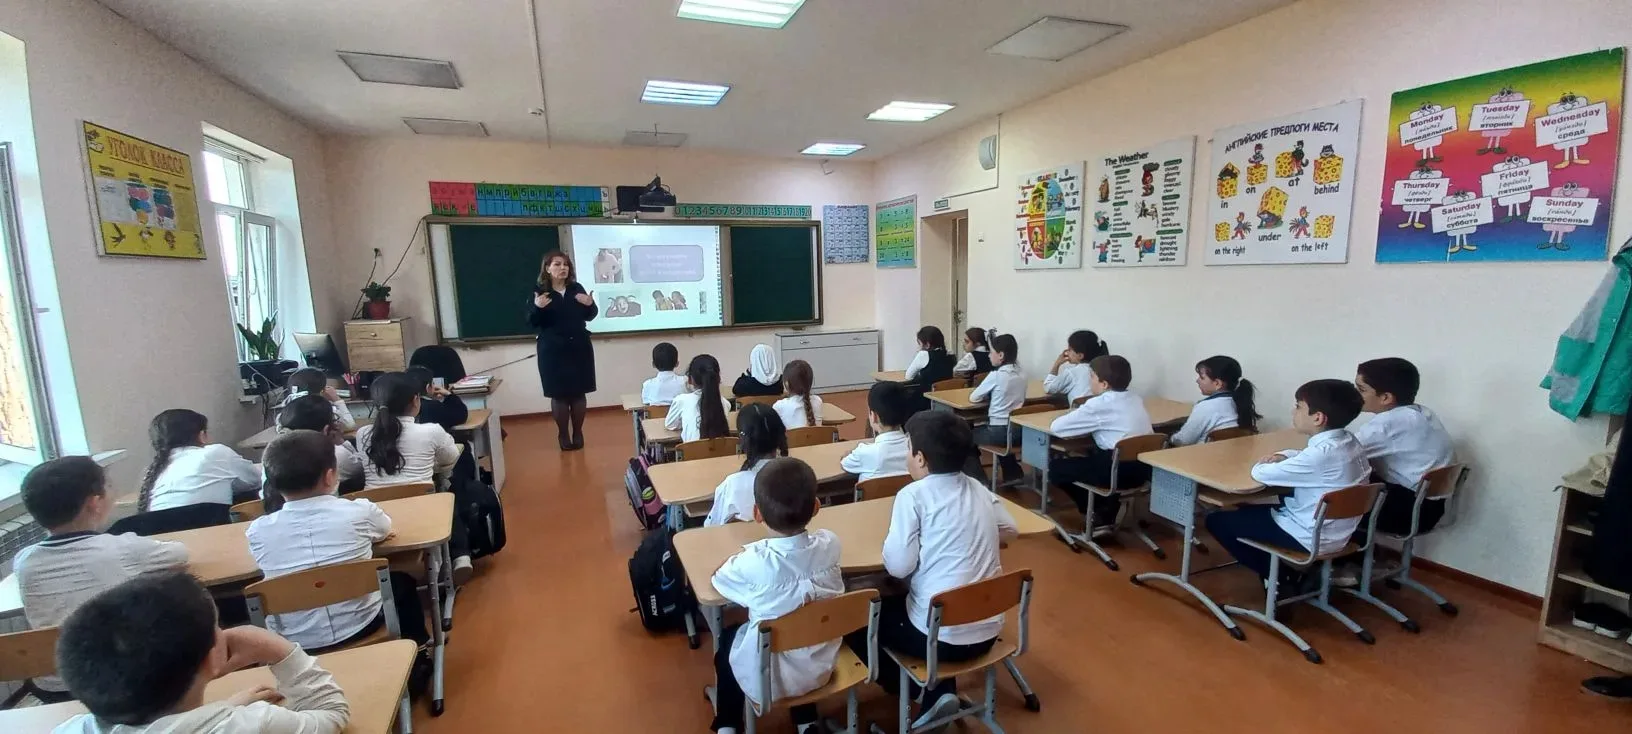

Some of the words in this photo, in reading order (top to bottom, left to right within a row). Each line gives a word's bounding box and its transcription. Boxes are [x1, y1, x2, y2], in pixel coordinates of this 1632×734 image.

[1481, 104, 1520, 113] Tuesday
[1410, 113, 1444, 128] Monday
[1541, 108, 1600, 127] Wednesday
[1480, 121, 1513, 129] вторник
[1225, 129, 1268, 153] АНГЛИЙСКИЕ
[1270, 122, 1310, 138] ПРЕДЛОГИ
[1312, 121, 1340, 133] МЕСТА
[1404, 125, 1454, 144] понедельник
[1557, 128, 1586, 141] среда
[1105, 157, 1117, 166] The
[1118, 152, 1149, 164] Weather
[1499, 168, 1529, 181] Friday
[1288, 177, 1300, 187] at
[1403, 181, 1440, 190] Thursday
[1246, 186, 1256, 194] on
[1314, 183, 1340, 195] behind
[1220, 200, 1228, 209] in
[1441, 202, 1481, 215] Saturday
[1545, 198, 1584, 208] Sunday
[1446, 218, 1478, 229] суббота
[1258, 232, 1281, 242] under
[1222, 247, 1231, 255] the
[1232, 246, 1246, 257] right
[1301, 242, 1312, 252] the
[1314, 242, 1328, 252] left
